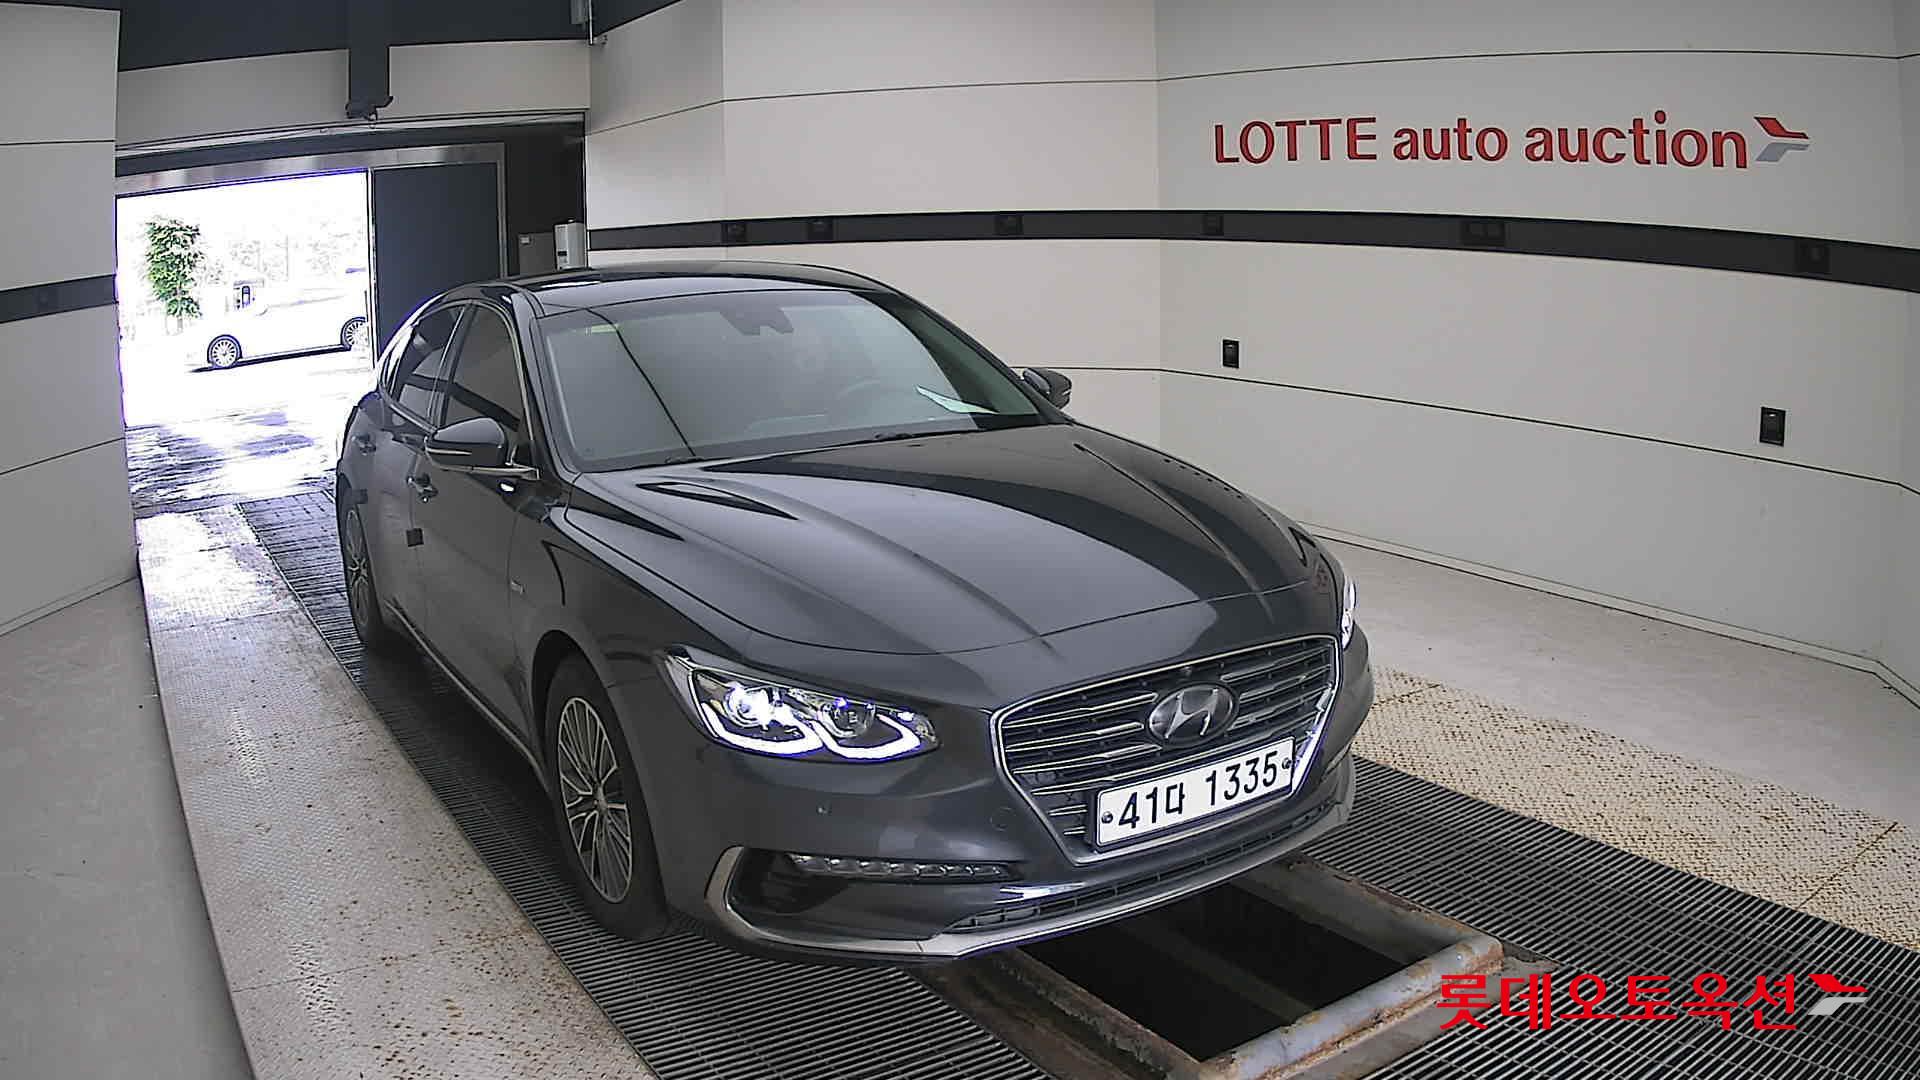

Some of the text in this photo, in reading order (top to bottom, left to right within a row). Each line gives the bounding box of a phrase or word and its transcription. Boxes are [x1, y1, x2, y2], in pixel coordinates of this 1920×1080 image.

[1213, 110, 1749, 169] LOTTE auto auction
[1118, 750, 1278, 829] 41다 1335
